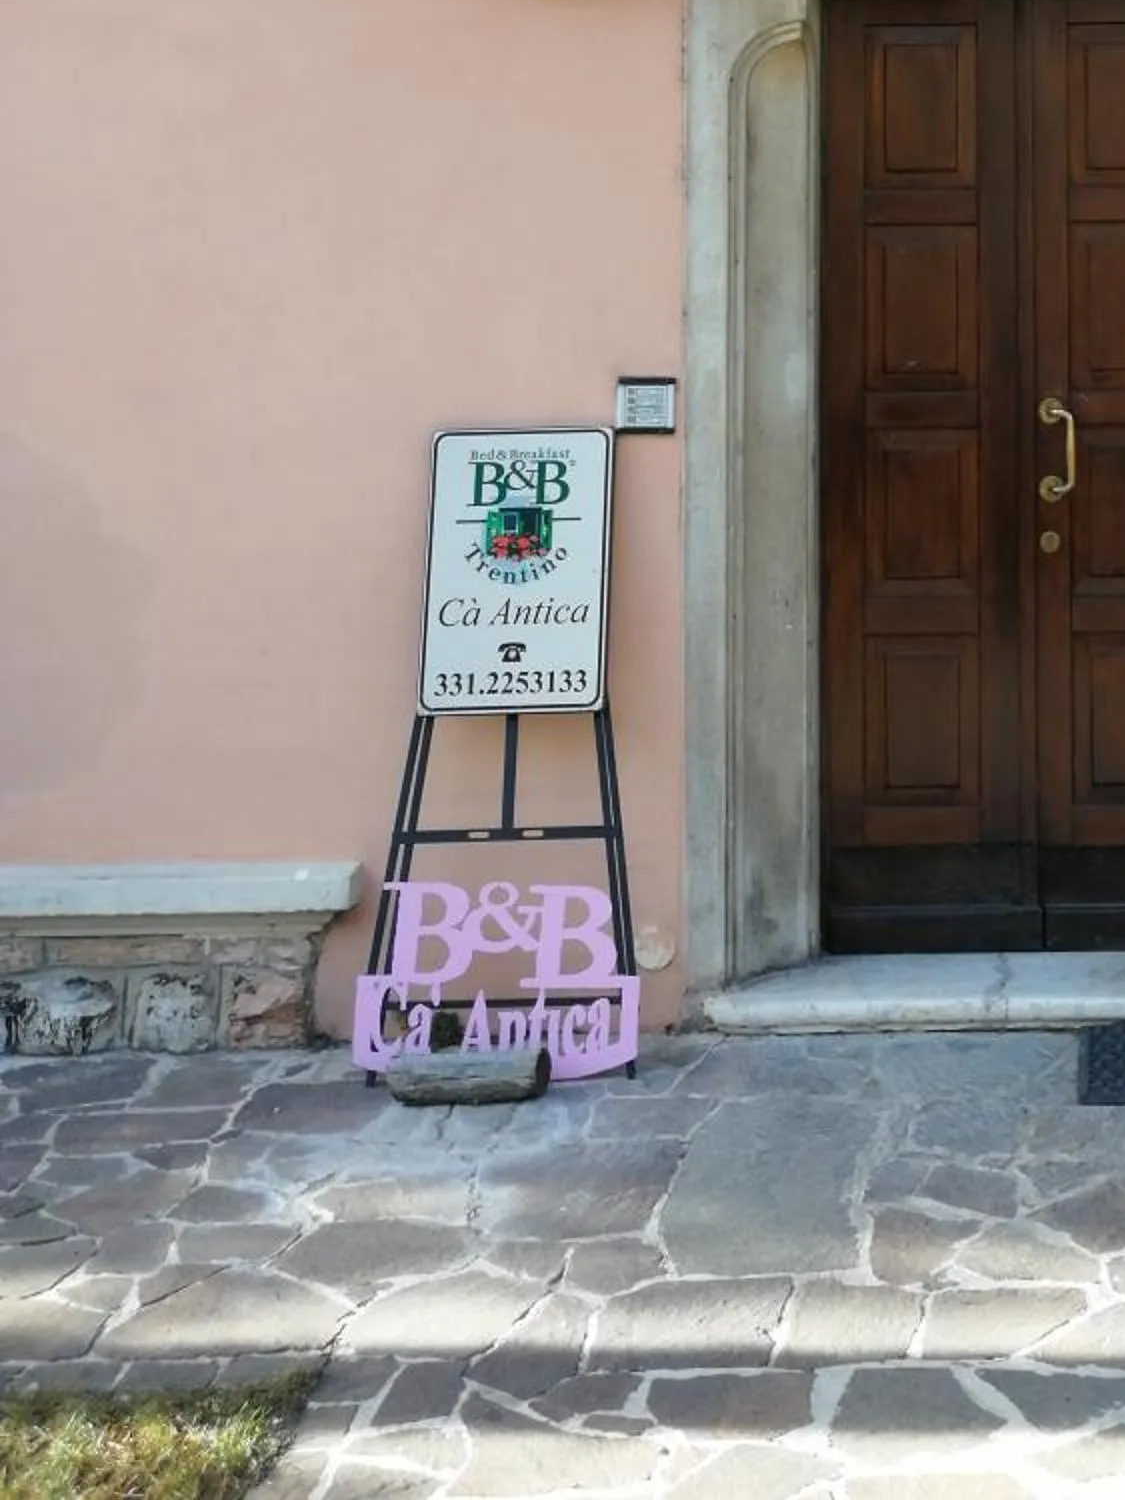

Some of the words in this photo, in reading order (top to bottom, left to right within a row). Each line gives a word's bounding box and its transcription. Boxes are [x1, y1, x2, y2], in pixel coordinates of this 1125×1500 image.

[466, 459, 571, 507] B&B
[464, 540, 568, 585] Trentino
[438, 597, 482, 628] Cà
[489, 597, 590, 627] Antica
[433, 669, 588, 697] 331.2253133
[384, 881, 618, 989] B&B
[460, 988, 611, 1055] Antica
